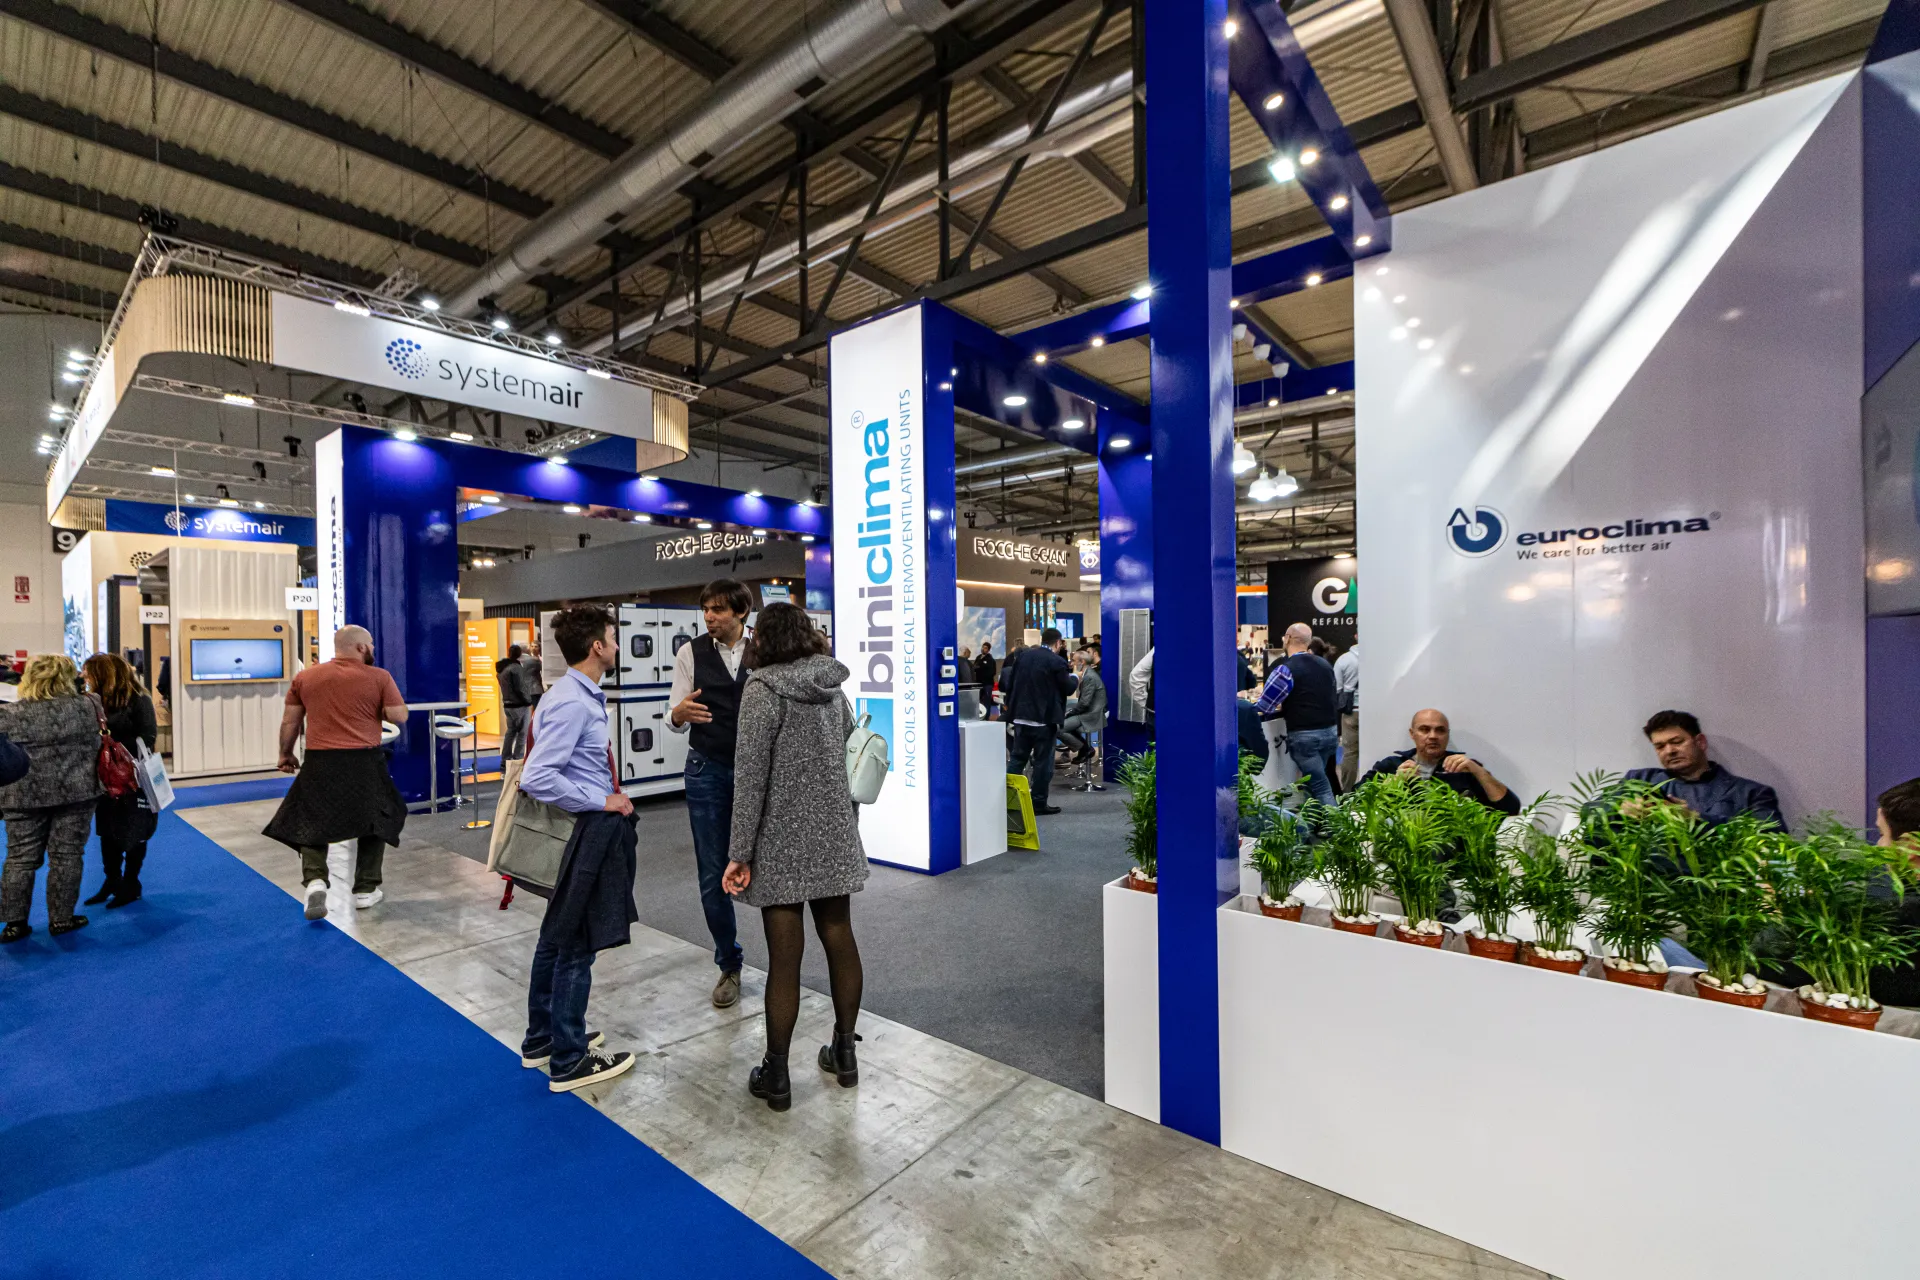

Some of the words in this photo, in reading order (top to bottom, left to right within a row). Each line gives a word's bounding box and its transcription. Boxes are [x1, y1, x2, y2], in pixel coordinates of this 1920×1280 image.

[439, 358, 583, 409] systemair
[899, 389, 911, 440] UNITS
[57, 531, 77, 551] 9
[194, 517, 285, 536] systemair
[900, 444, 915, 614] TERMOVENTILATING
[1516, 517, 1710, 546] euroclima
[857, 418, 893, 693] biniclima
[973, 537, 1067, 566] ROCCHEGGIANI
[1517, 550, 1538, 561] We
[1543, 548, 1571, 559] care
[1576, 545, 1596, 556] for
[1602, 541, 1645, 554] better
[1651, 540, 1672, 550] air
[1312, 617, 1358, 626] REFRIG
[904, 620, 916, 685] SPECIAL
[904, 689, 916, 702] &
[904, 706, 916, 788] FANCOILS
